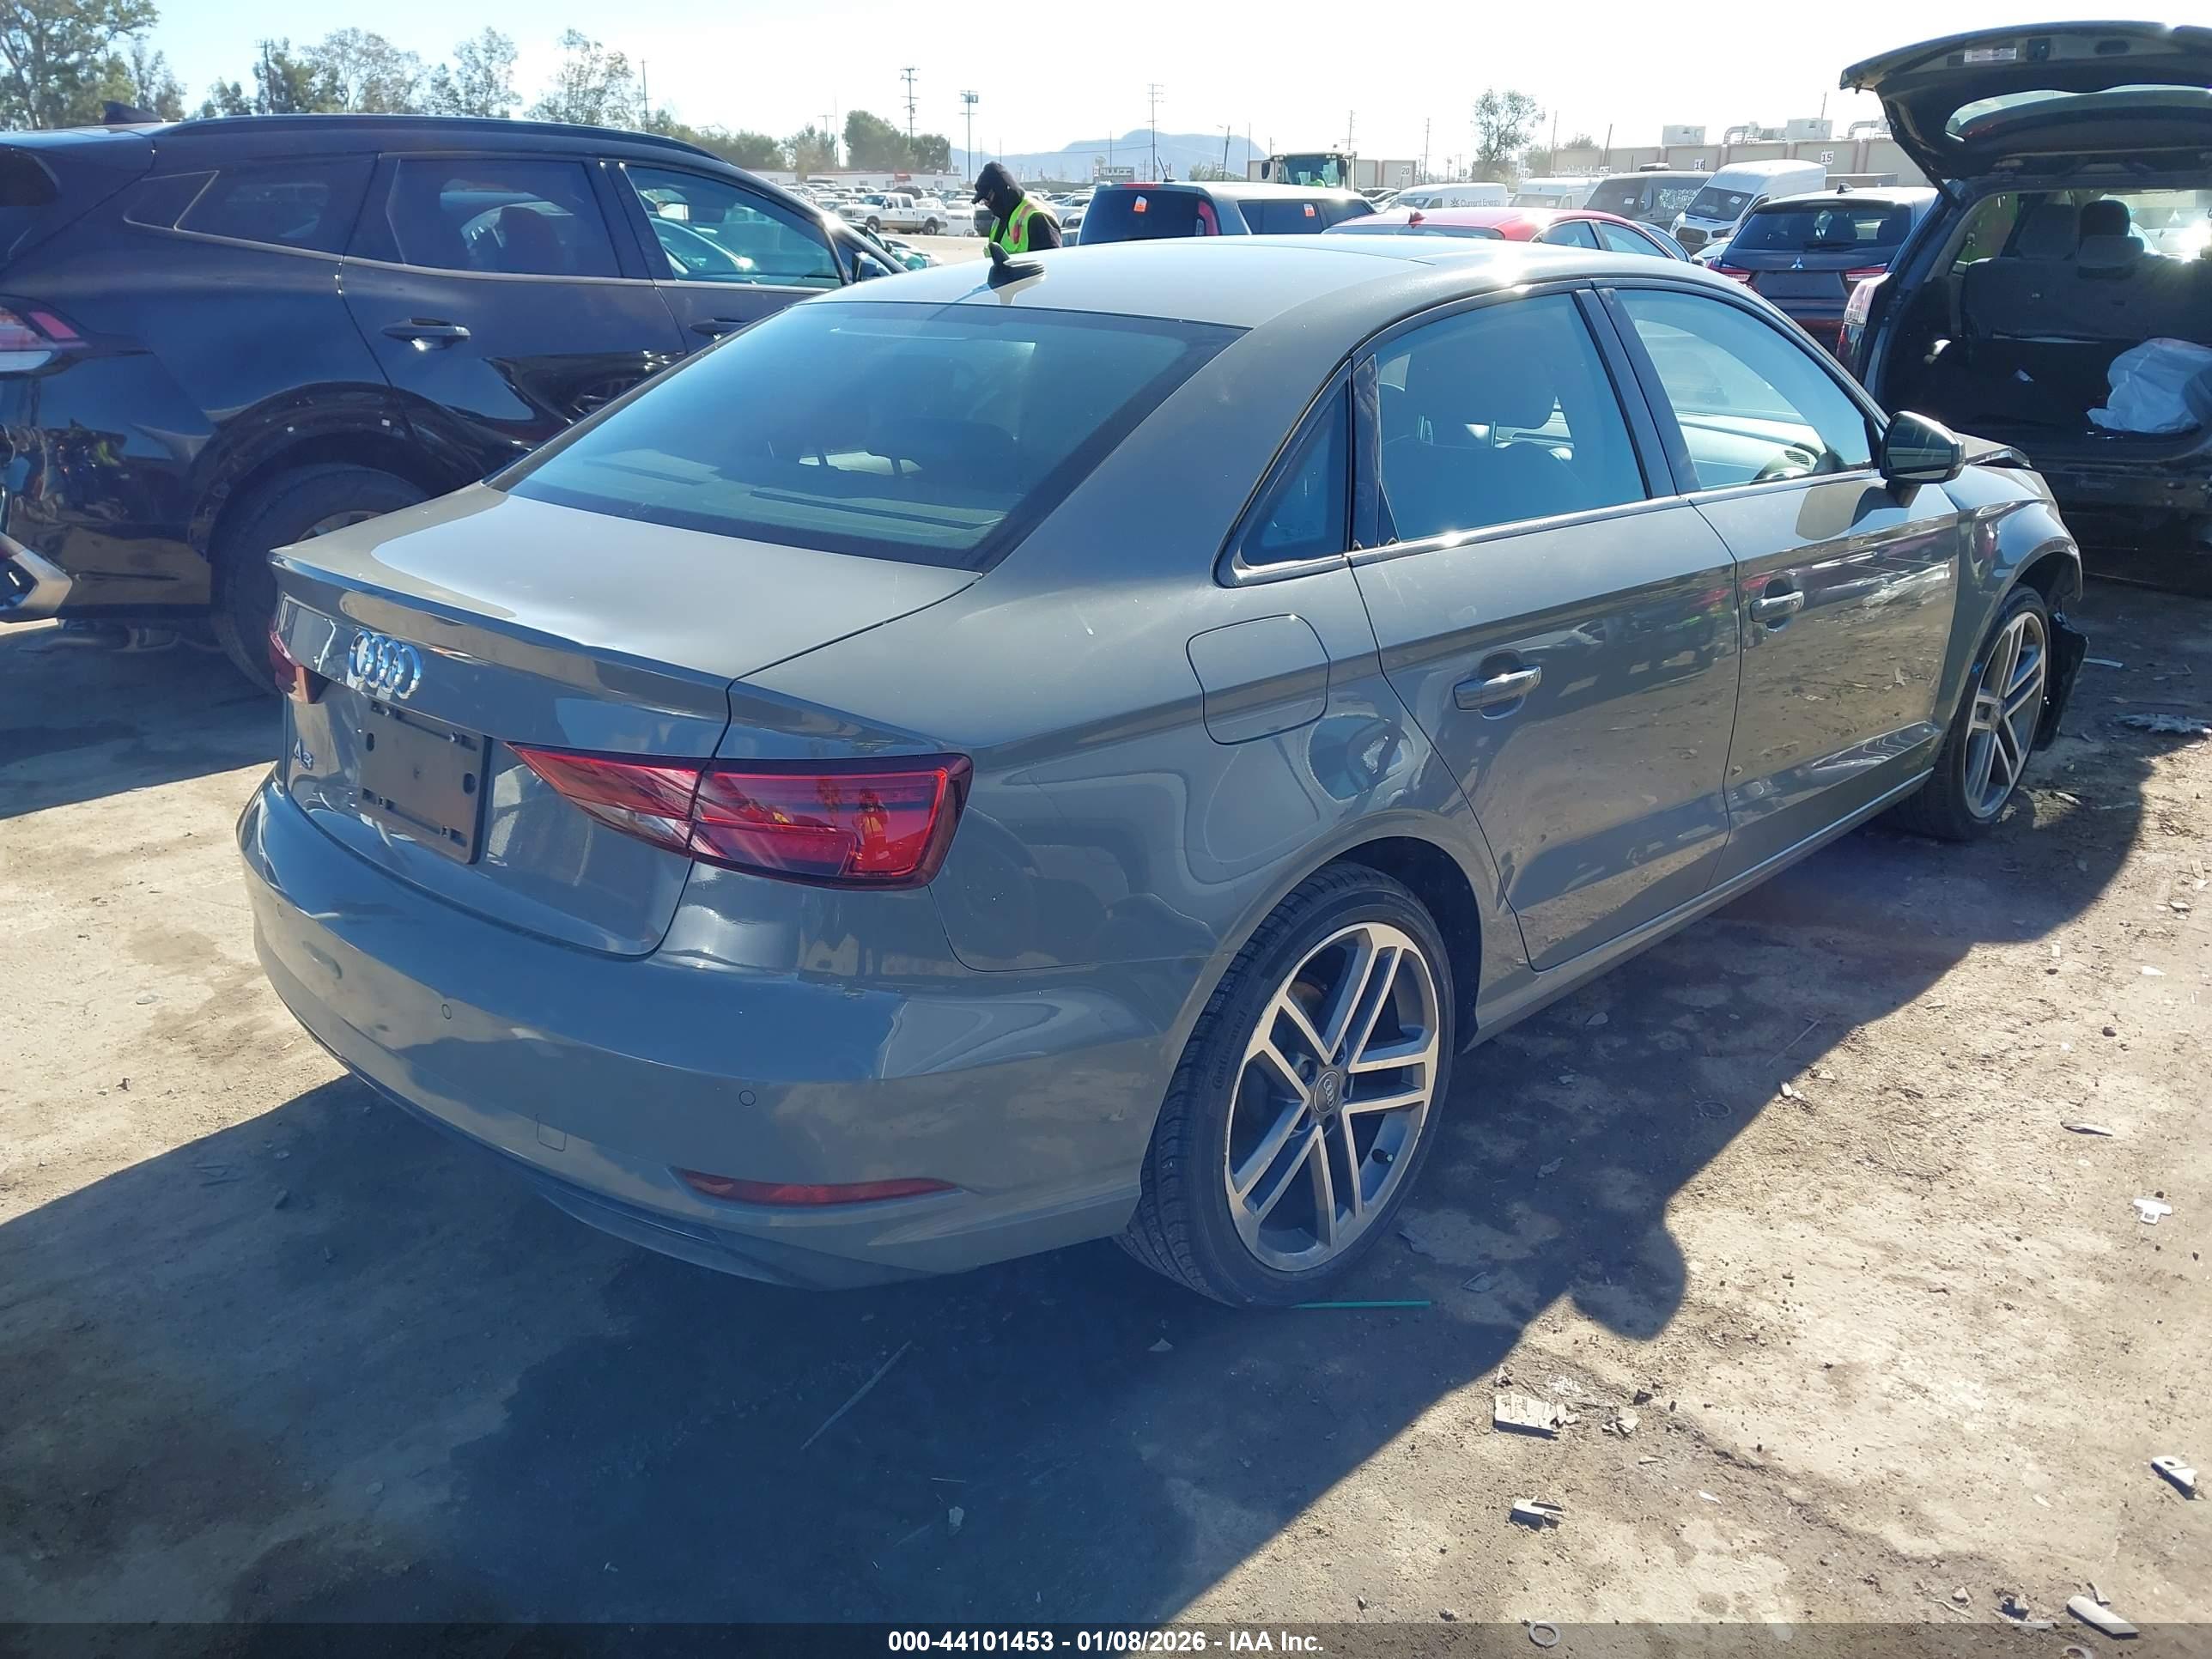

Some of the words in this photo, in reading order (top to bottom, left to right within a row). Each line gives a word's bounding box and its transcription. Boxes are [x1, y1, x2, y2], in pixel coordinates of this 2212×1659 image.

[1820, 153, 1832, 162] 15
[1695, 161, 1705, 170] 16
[1401, 167, 1410, 175] 20
[294, 738, 313, 769] A3
